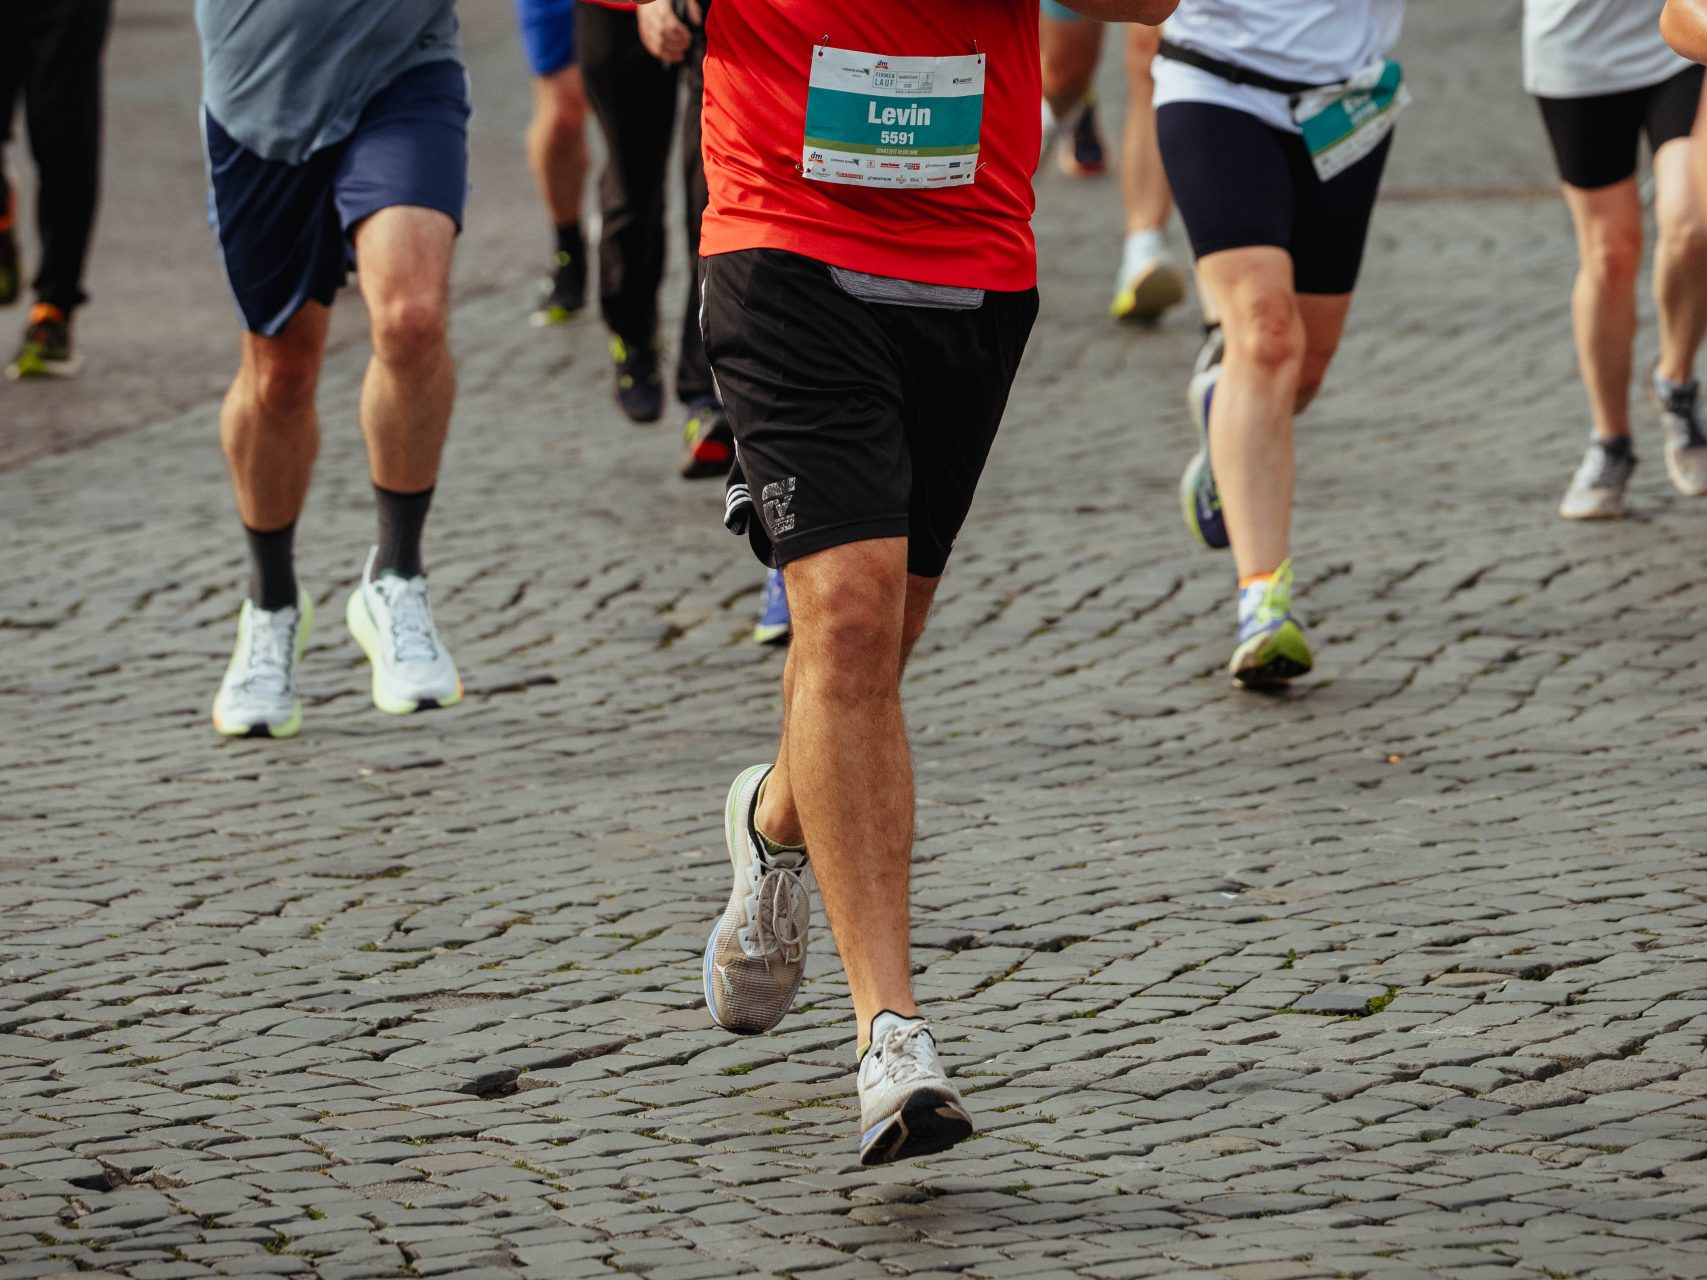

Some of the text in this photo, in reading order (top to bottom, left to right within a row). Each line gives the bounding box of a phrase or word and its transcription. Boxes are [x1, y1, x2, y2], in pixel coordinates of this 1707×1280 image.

[875, 71, 896, 79] FIRMEN
[874, 78, 895, 87] LAUF
[868, 101, 931, 126] Levin
[880, 130, 915, 145] 5591
[810, 151, 823, 159] dm
